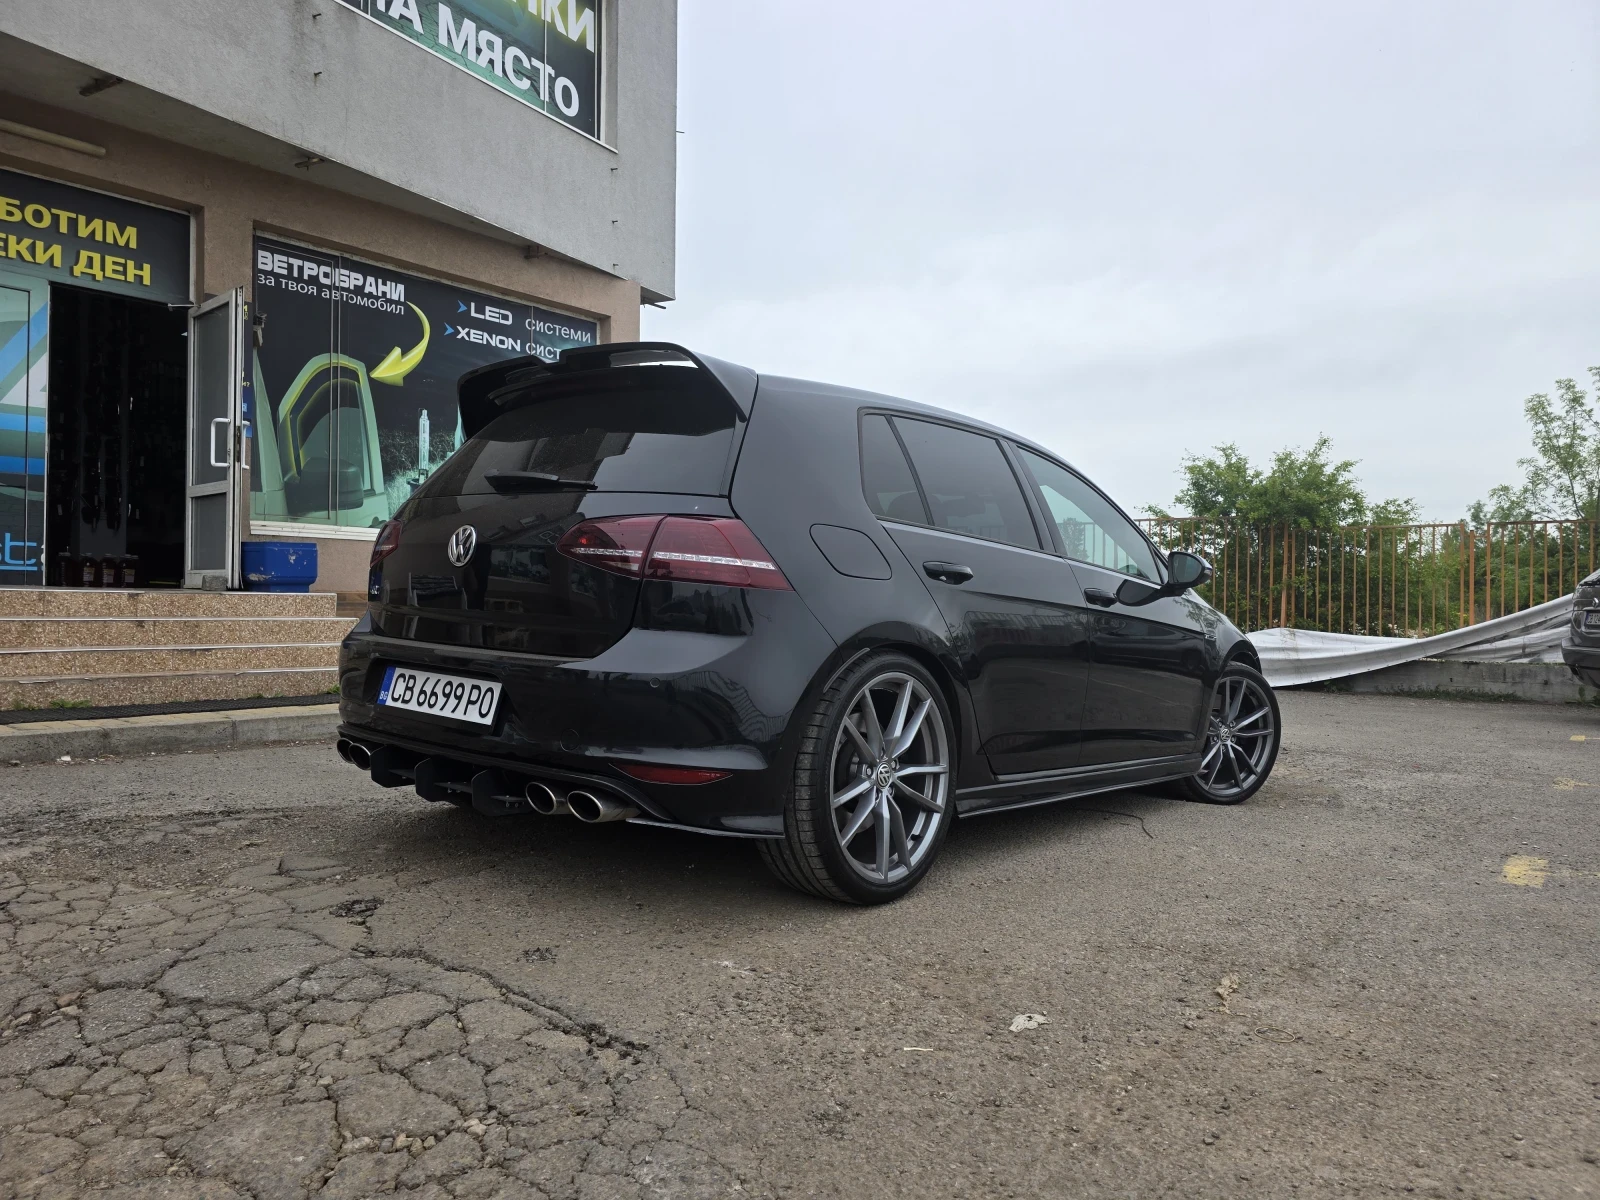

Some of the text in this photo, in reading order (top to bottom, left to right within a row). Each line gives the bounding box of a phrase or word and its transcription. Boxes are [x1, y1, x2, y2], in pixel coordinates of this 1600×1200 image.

[508, 0, 595, 53] КИ
[377, 0, 580, 117] А МЯСТО
[73, 249, 151, 286] ДЕН
[257, 249, 405, 303] ВЕТРОБРАНИ
[257, 273, 405, 316] за твоя автомобил
[470, 301, 513, 326] LED
[525, 318, 591, 344] системи
[456, 325, 521, 352] XENON
[0, 532, 37, 565] t
